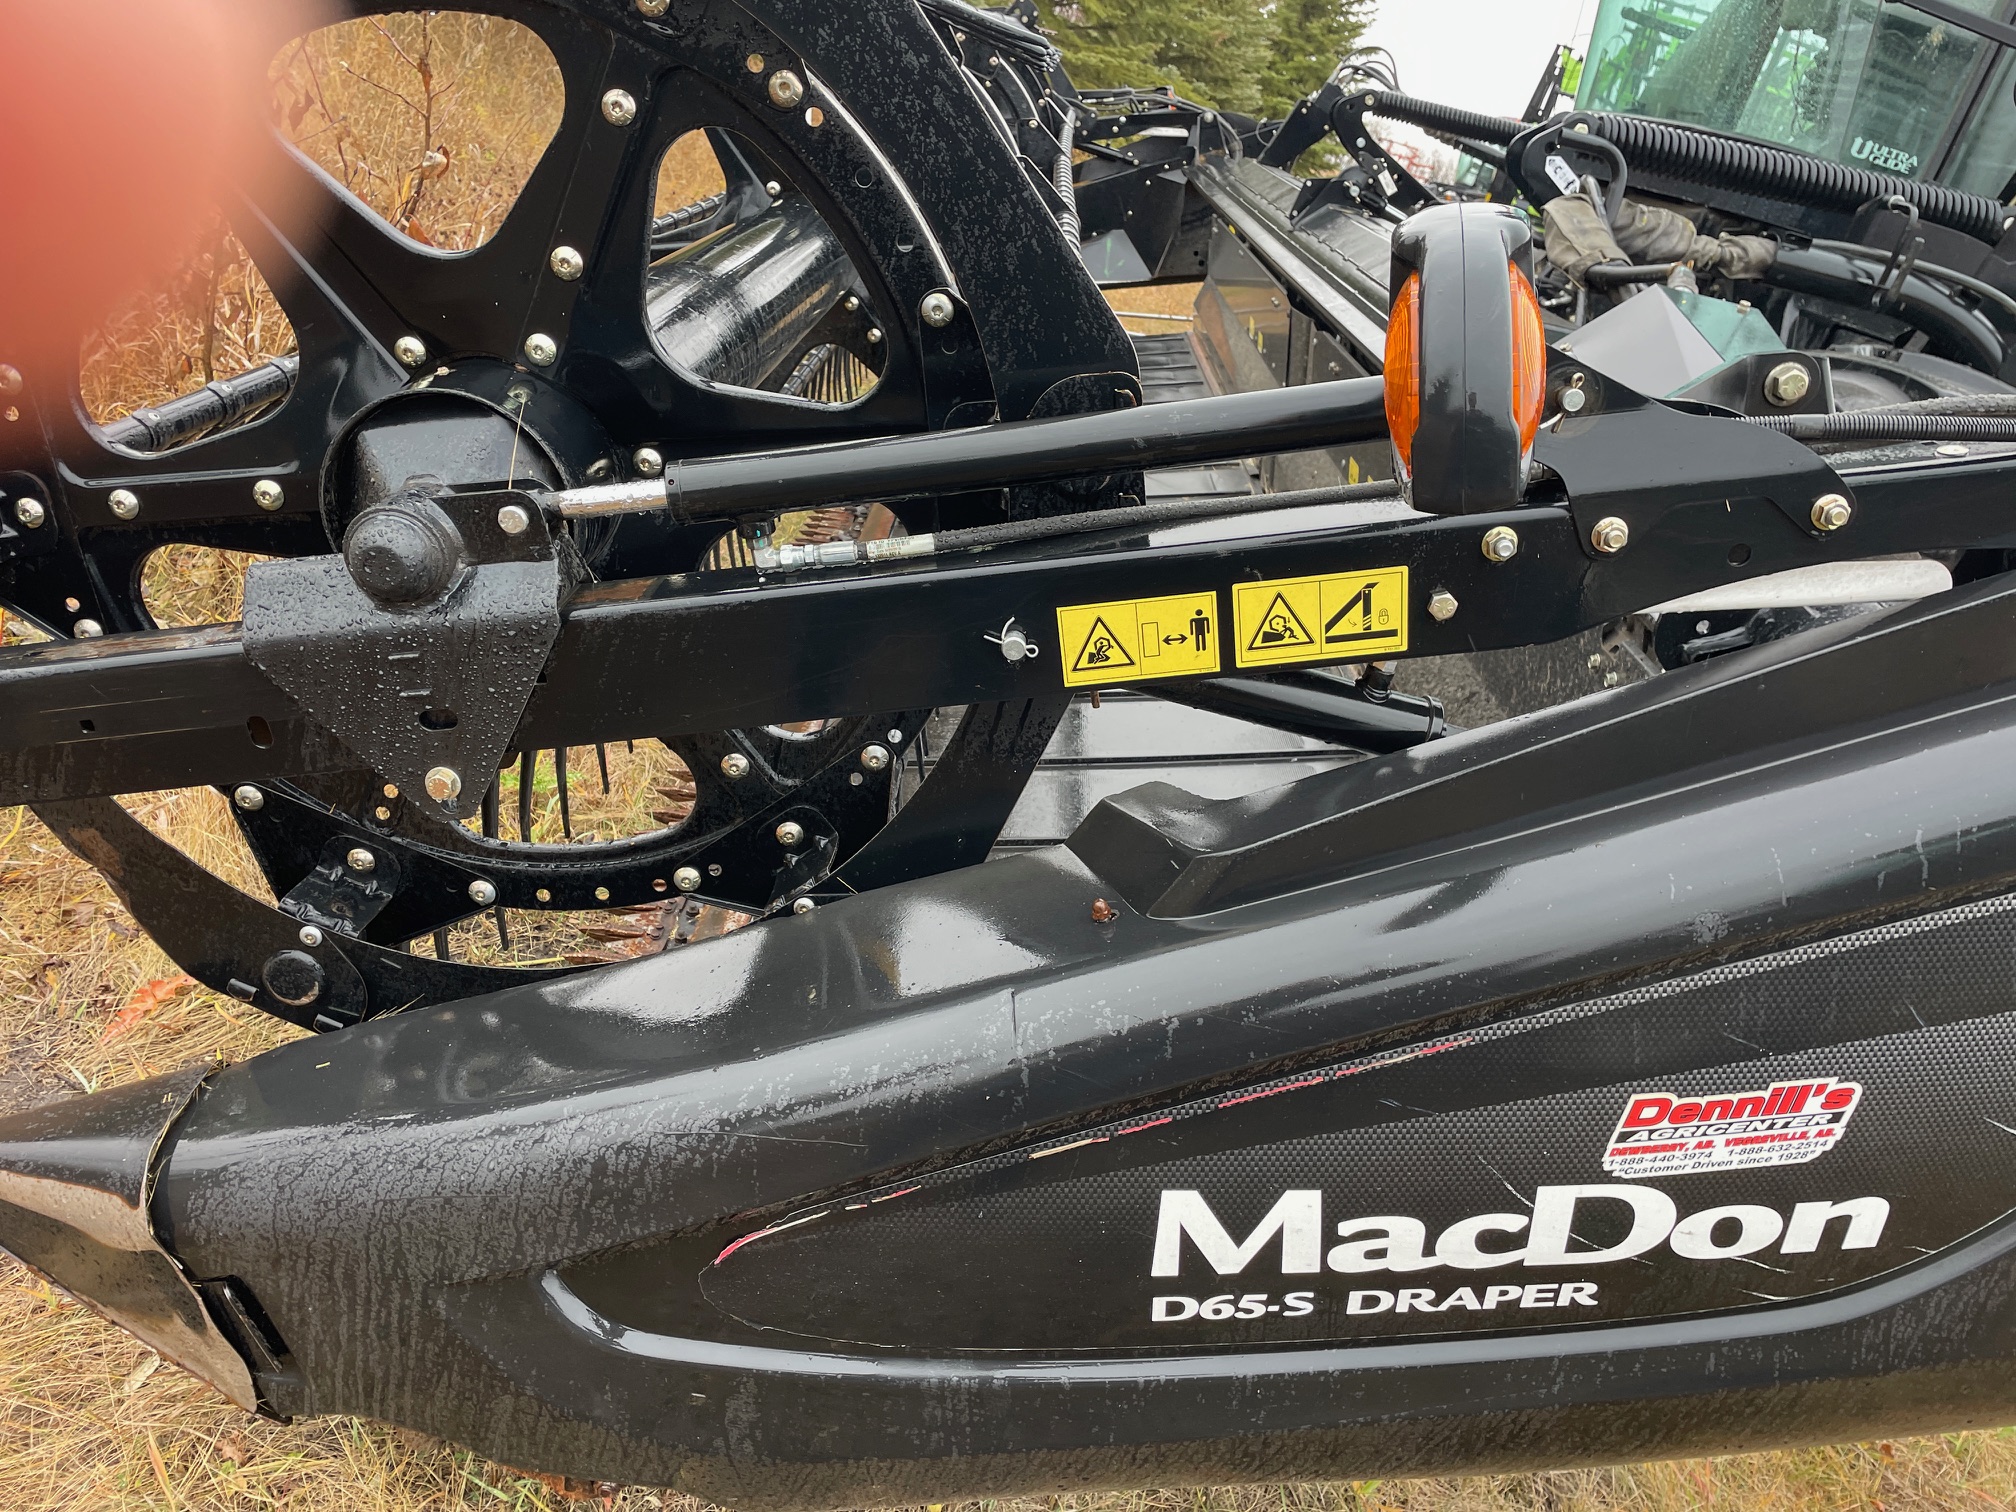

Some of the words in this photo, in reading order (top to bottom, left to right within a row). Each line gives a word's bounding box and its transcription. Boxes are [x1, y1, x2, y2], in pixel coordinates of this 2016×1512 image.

[1869, 153, 1909, 174] GLIDE
[1873, 143, 1918, 167] ULTRA
[1621, 1084, 1855, 1129] Dennill's
[1625, 1113, 1833, 1142] AGRICENTER
[1608, 1150, 1713, 1167] 1-888-440-3974
[1727, 1139, 1828, 1157] 1-888-632-2514
[1692, 1160, 1732, 1170] Driven
[1737, 1156, 1773, 1166] since
[1150, 1184, 1891, 1277] MacDon
[1151, 1291, 1315, 1322] D65-S
[1345, 1281, 1600, 1314] DRAPER
